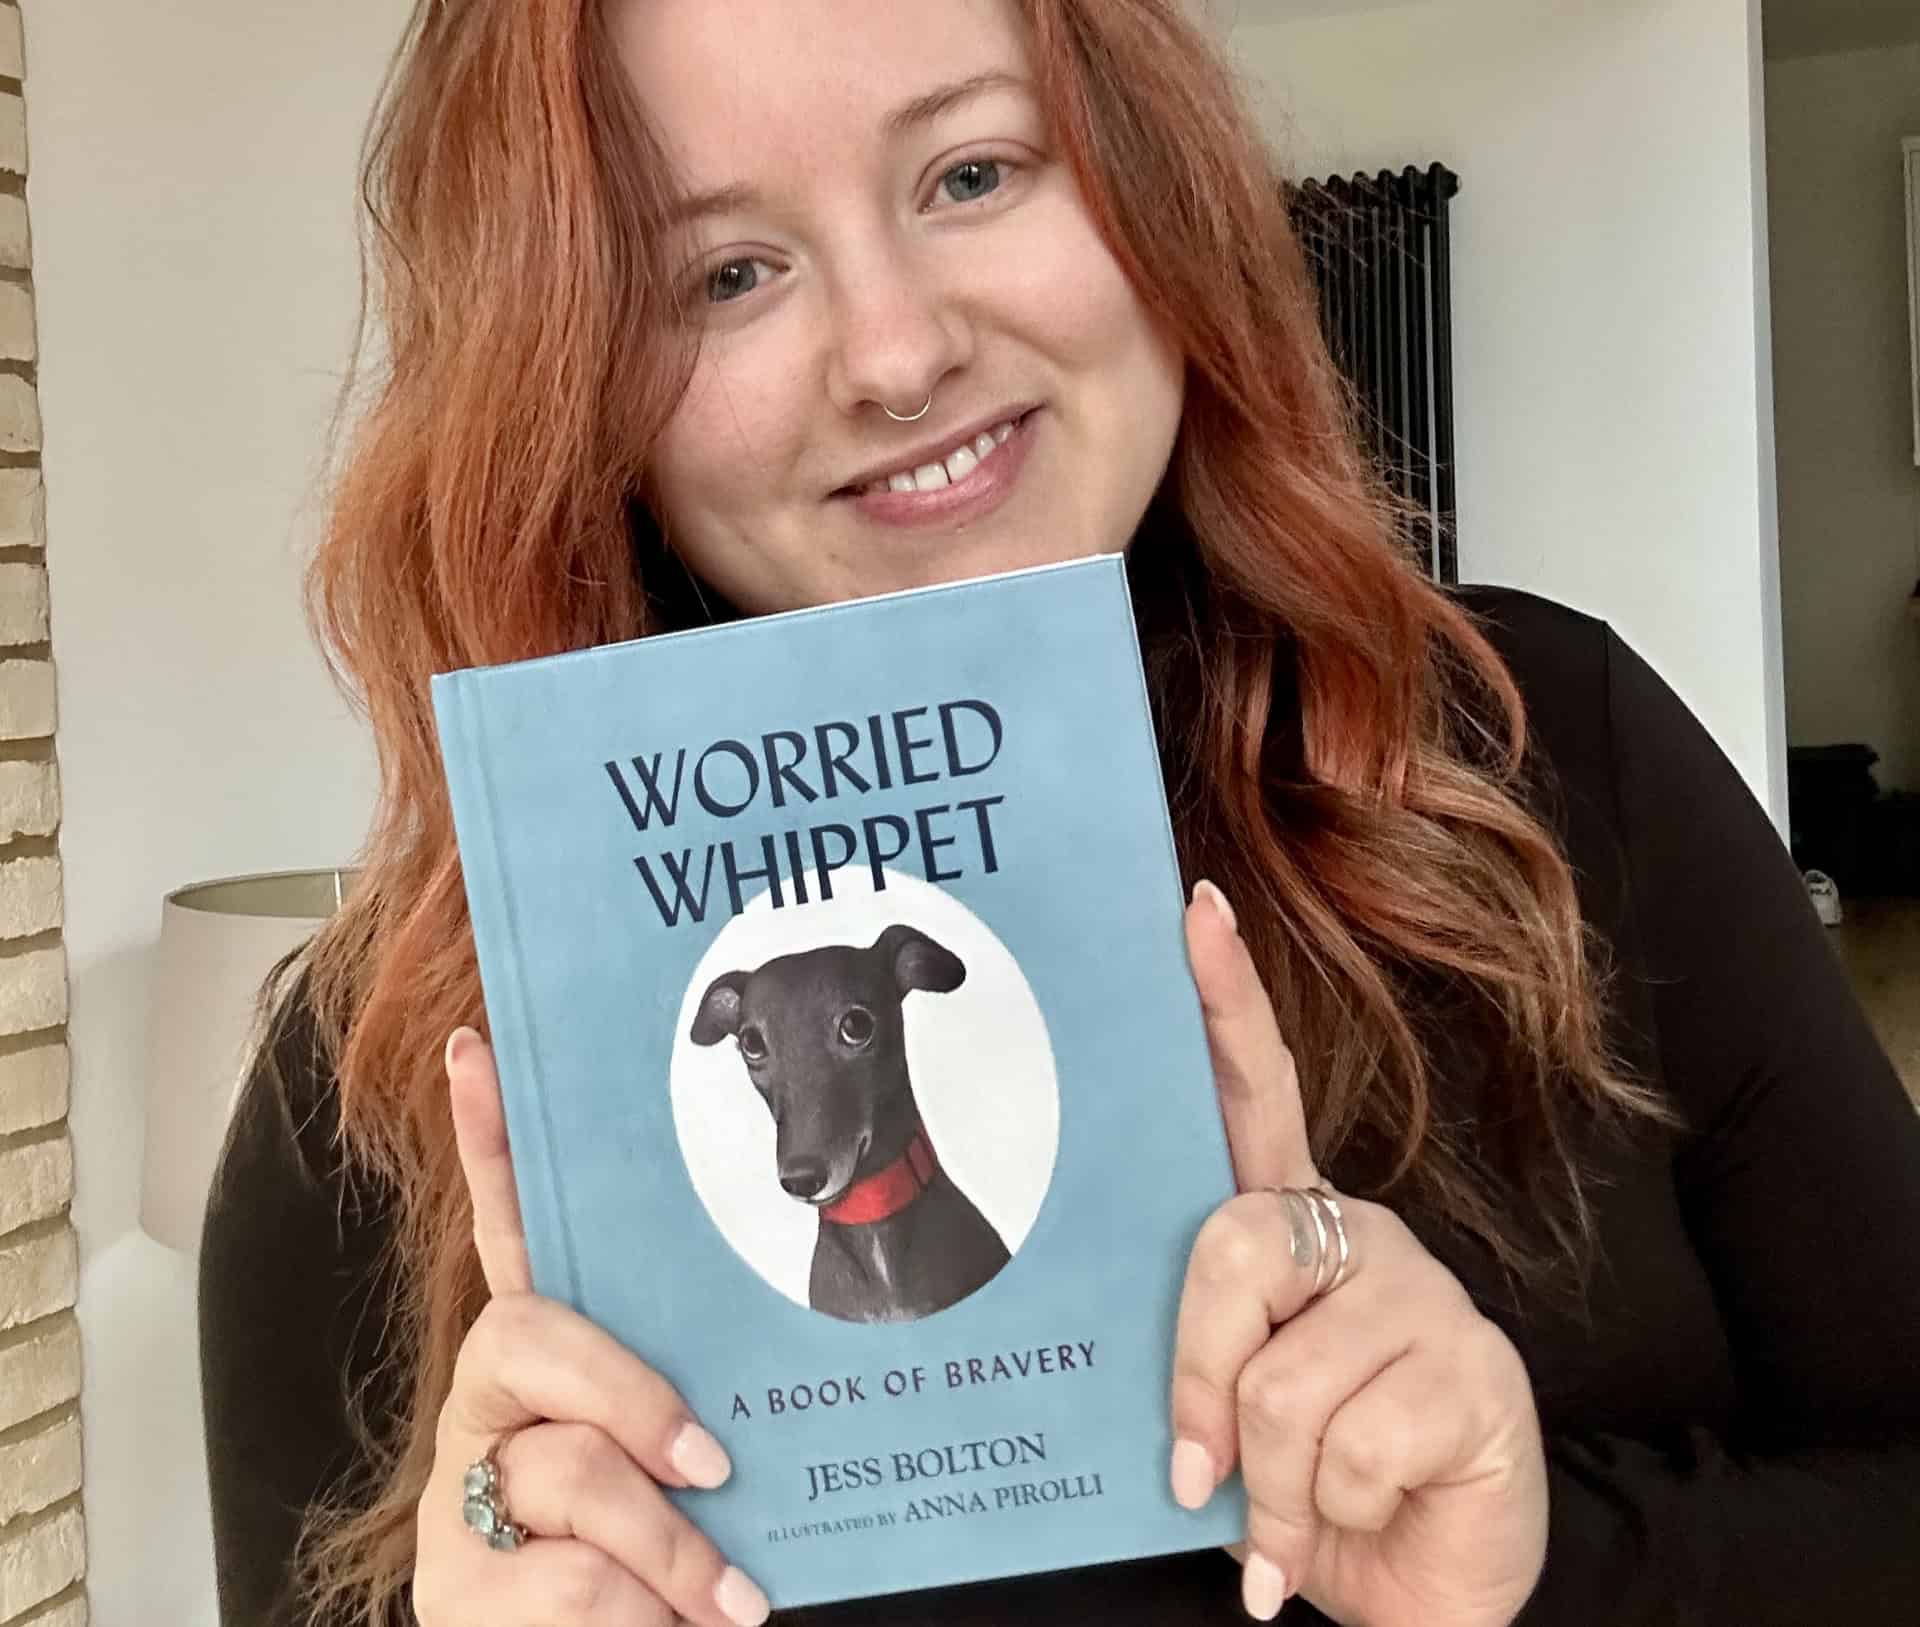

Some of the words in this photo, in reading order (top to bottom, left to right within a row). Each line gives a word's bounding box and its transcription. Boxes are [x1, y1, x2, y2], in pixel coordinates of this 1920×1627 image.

[604, 699, 1002, 832] WORRIED
[633, 795, 1005, 927] WHIPPET
[731, 1393, 752, 1421] A
[767, 1375, 866, 1415] BOOK
[884, 1367, 927, 1397] OF
[945, 1341, 1097, 1389] BRAVERY
[806, 1457, 883, 1500] JESS
[890, 1433, 1047, 1482] BOLTON
[877, 1511, 898, 1527] BY
[905, 1490, 988, 1523] ANNA
[994, 1473, 1104, 1510] PIROLLI
